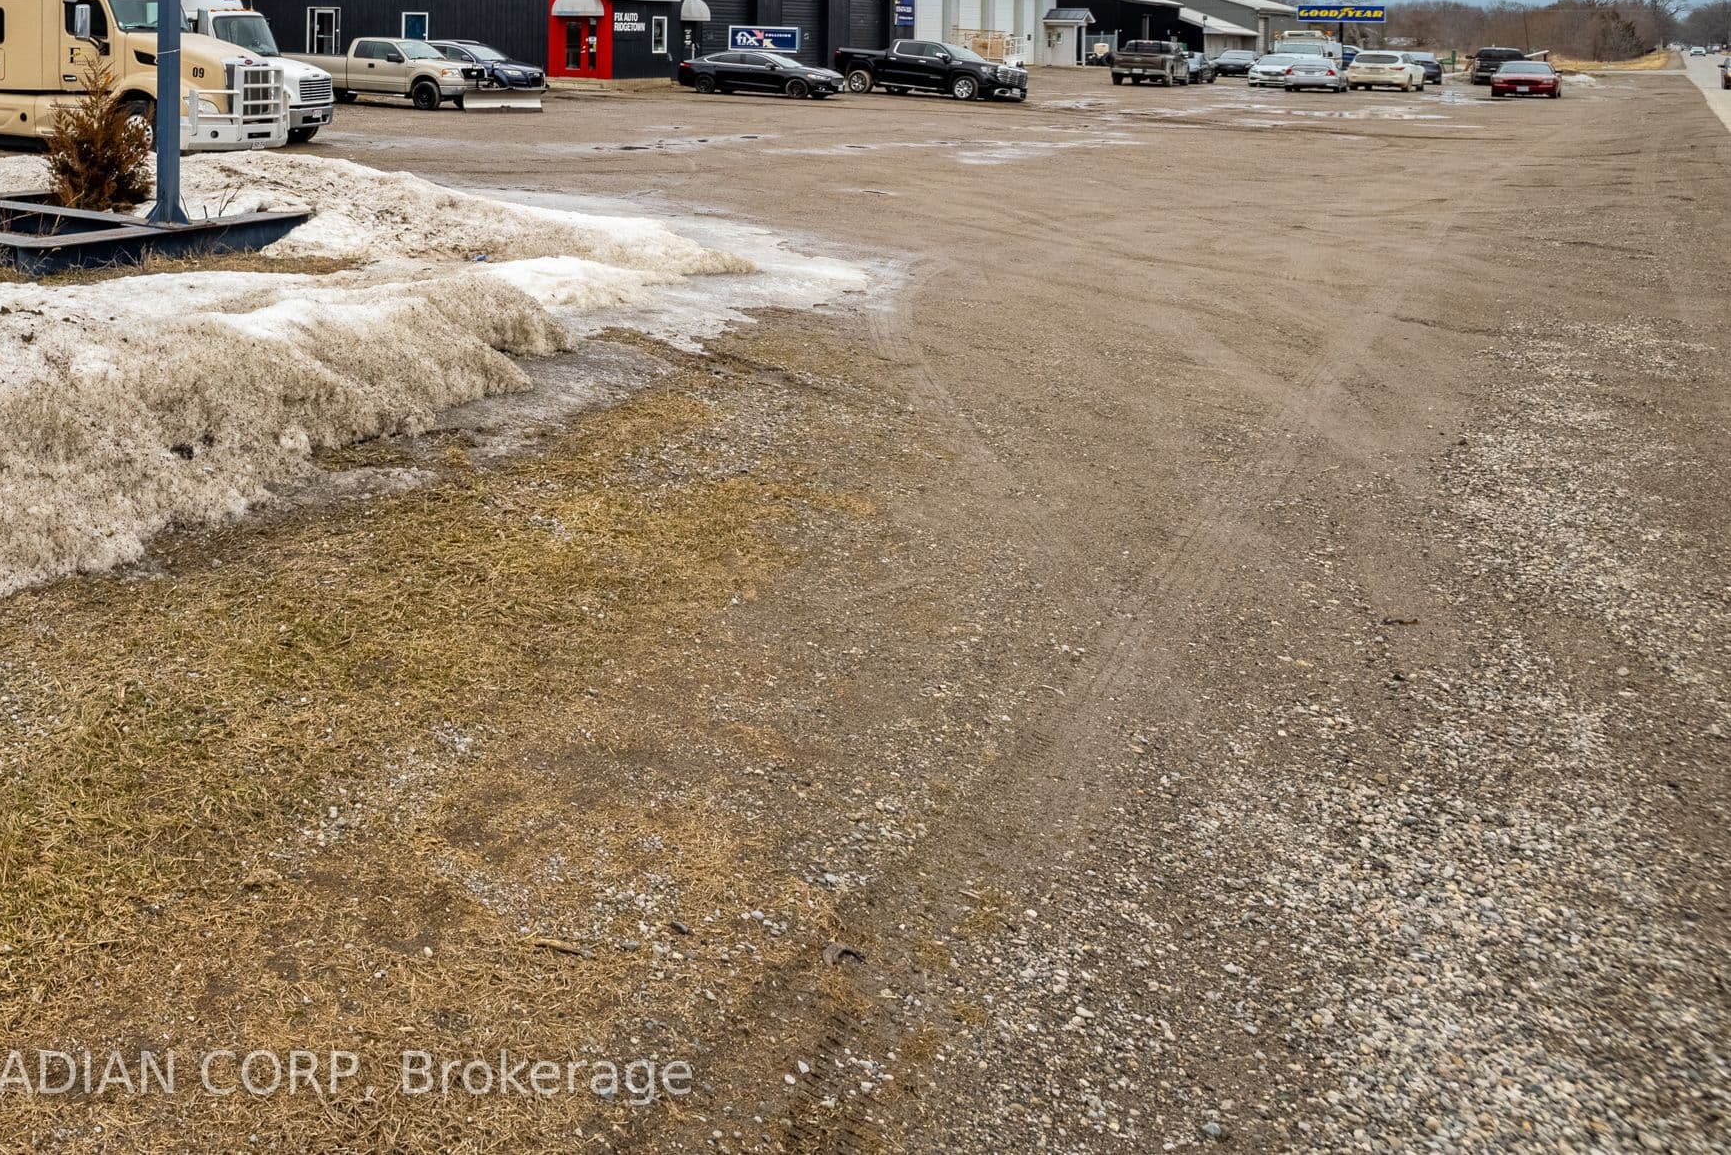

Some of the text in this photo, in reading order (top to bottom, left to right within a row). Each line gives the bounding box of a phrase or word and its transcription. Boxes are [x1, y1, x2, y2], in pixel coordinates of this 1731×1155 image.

[614, 12, 639, 22] FIX AUTO
[1299, 8, 1384, 18] GOODYEAR
[614, 22, 646, 32] RIDGETOWN
[192, 67, 205, 78] 09
